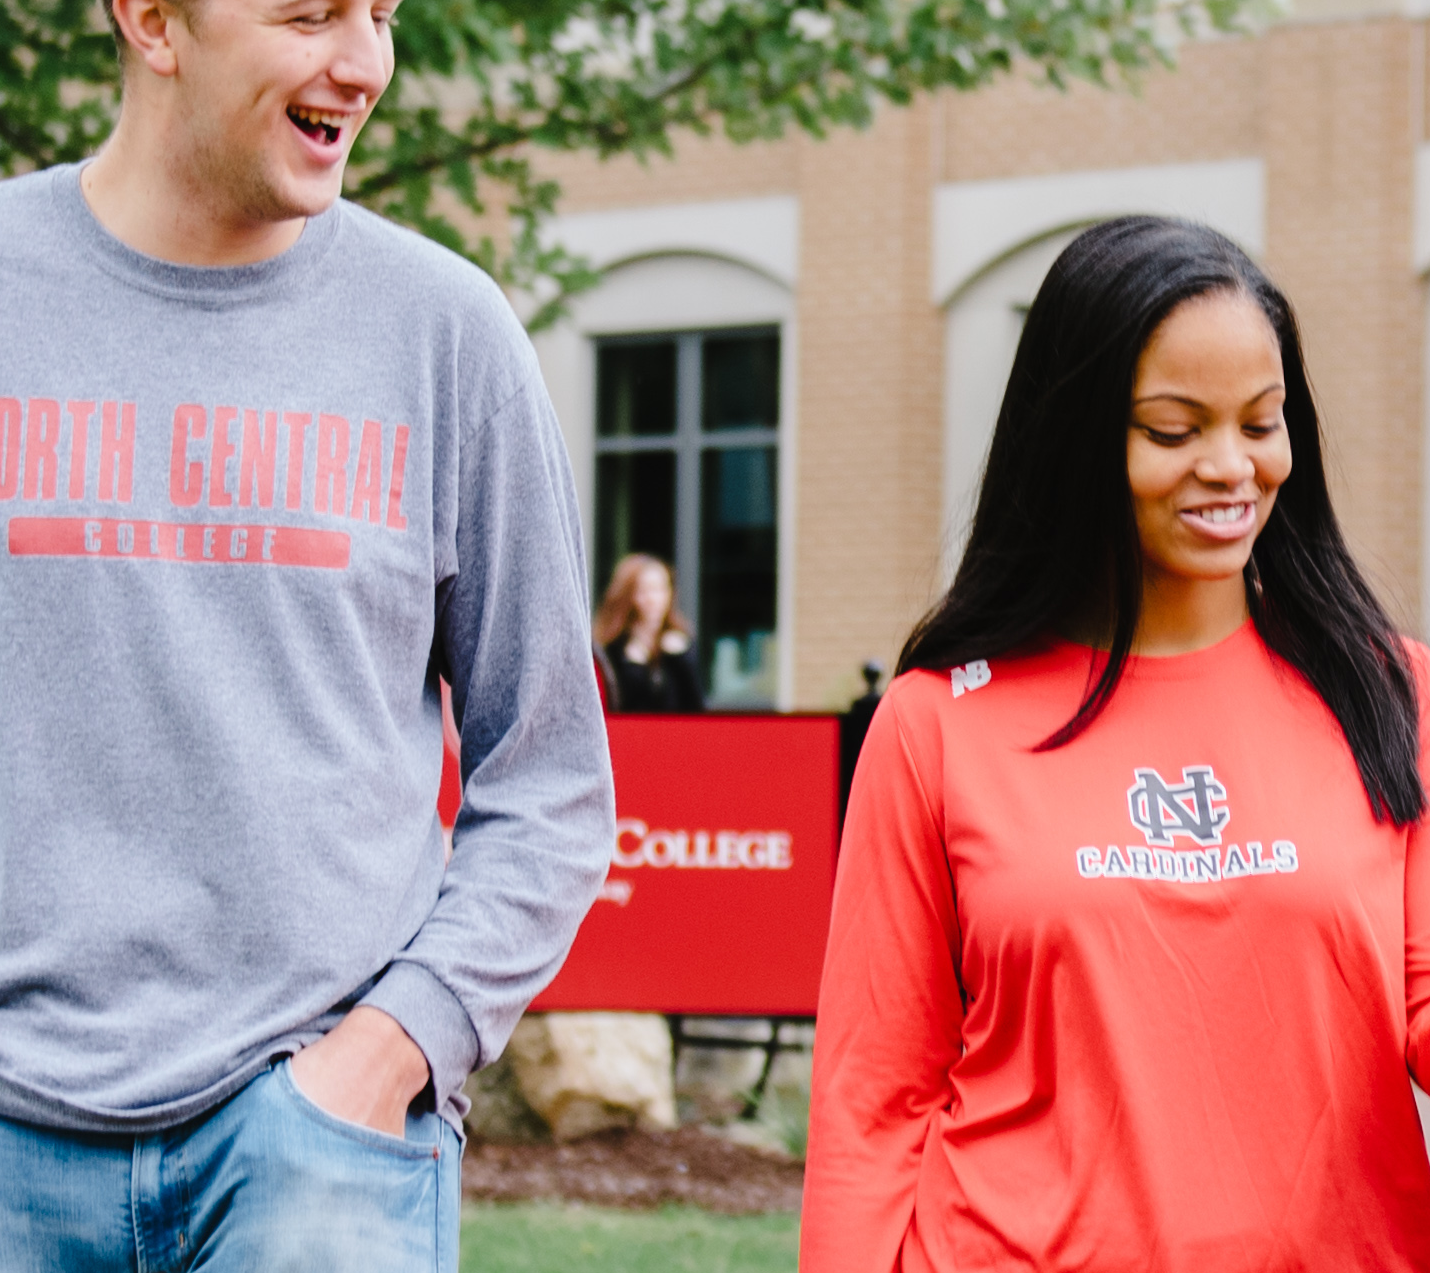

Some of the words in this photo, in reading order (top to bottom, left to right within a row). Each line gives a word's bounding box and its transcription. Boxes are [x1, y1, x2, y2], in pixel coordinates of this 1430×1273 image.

[169, 403, 411, 531] CENTRAL
[84, 521, 277, 561] COLLEGE
[950, 658, 992, 699] NB
[1076, 840, 1299, 884] CARDINALS
